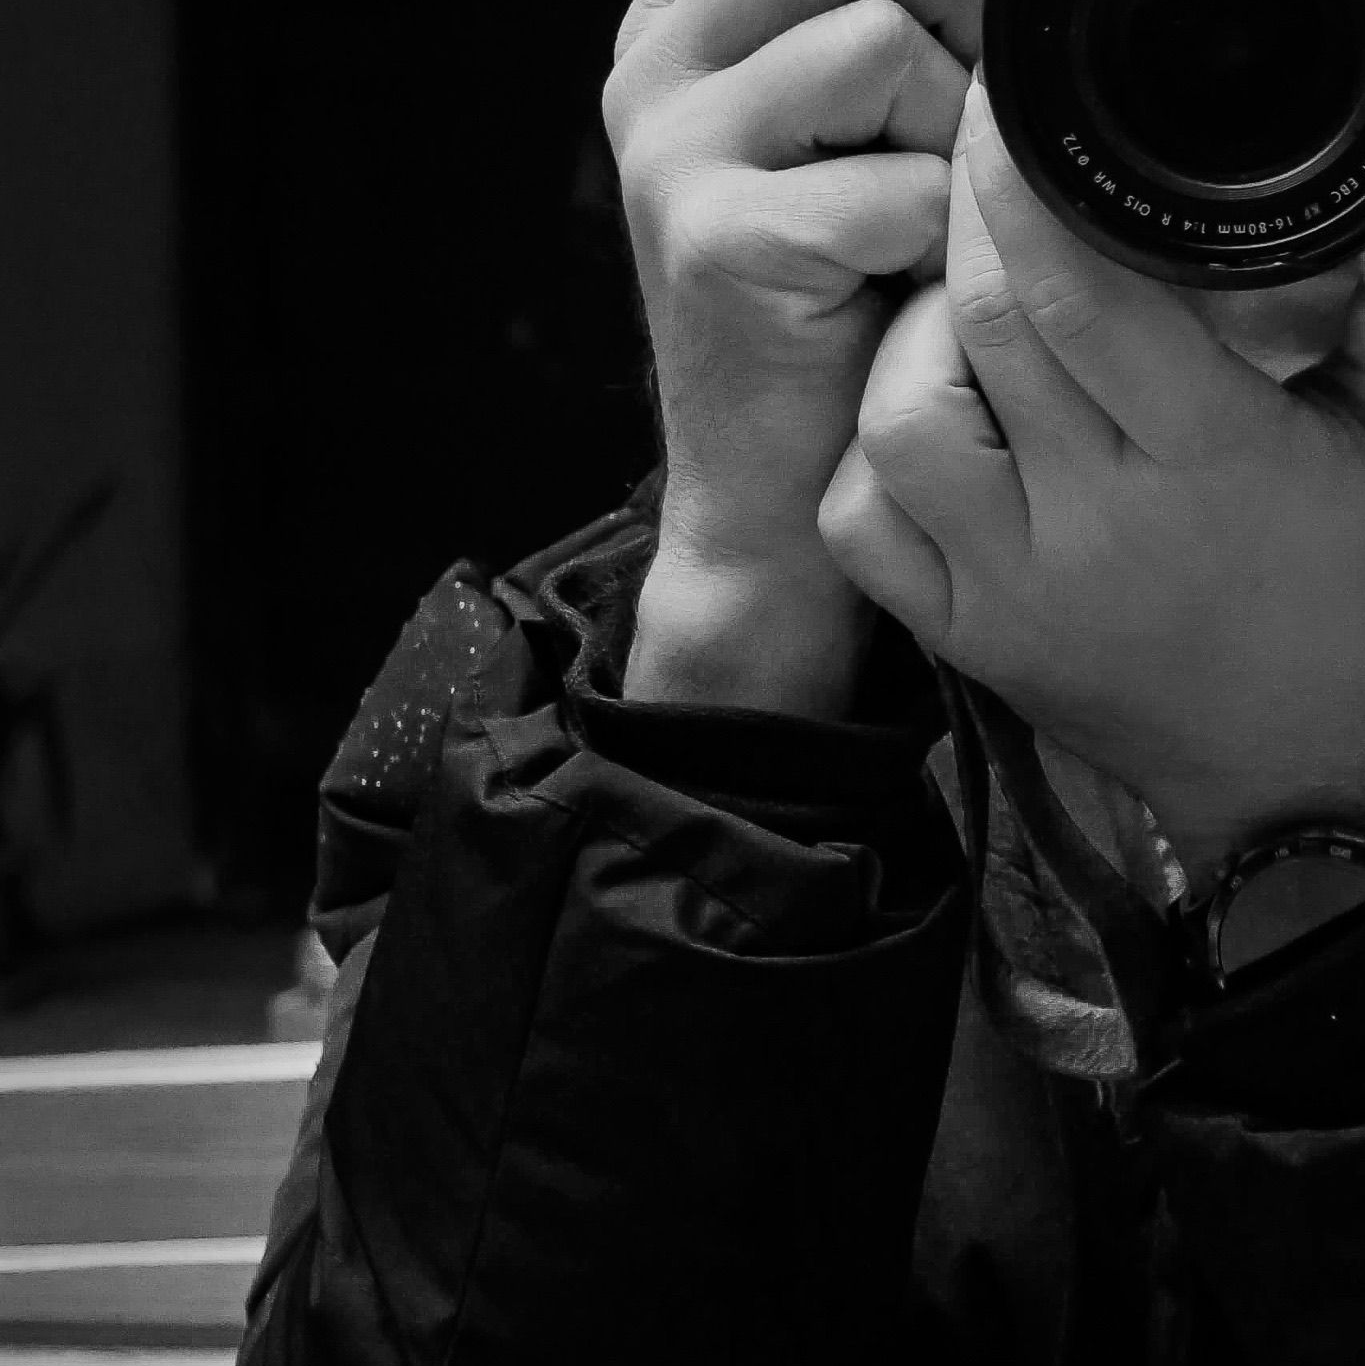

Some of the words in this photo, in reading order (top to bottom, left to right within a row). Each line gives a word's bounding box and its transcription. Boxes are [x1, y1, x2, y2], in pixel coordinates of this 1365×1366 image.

[1093, 171, 1118, 196] WR
[1330, 177, 1360, 204] EBC
[1124, 195, 1151, 217] OIS
[1161, 213, 1172, 226] R
[1184, 220, 1206, 234] 1:4
[1217, 215, 1294, 236] 16-80mm
